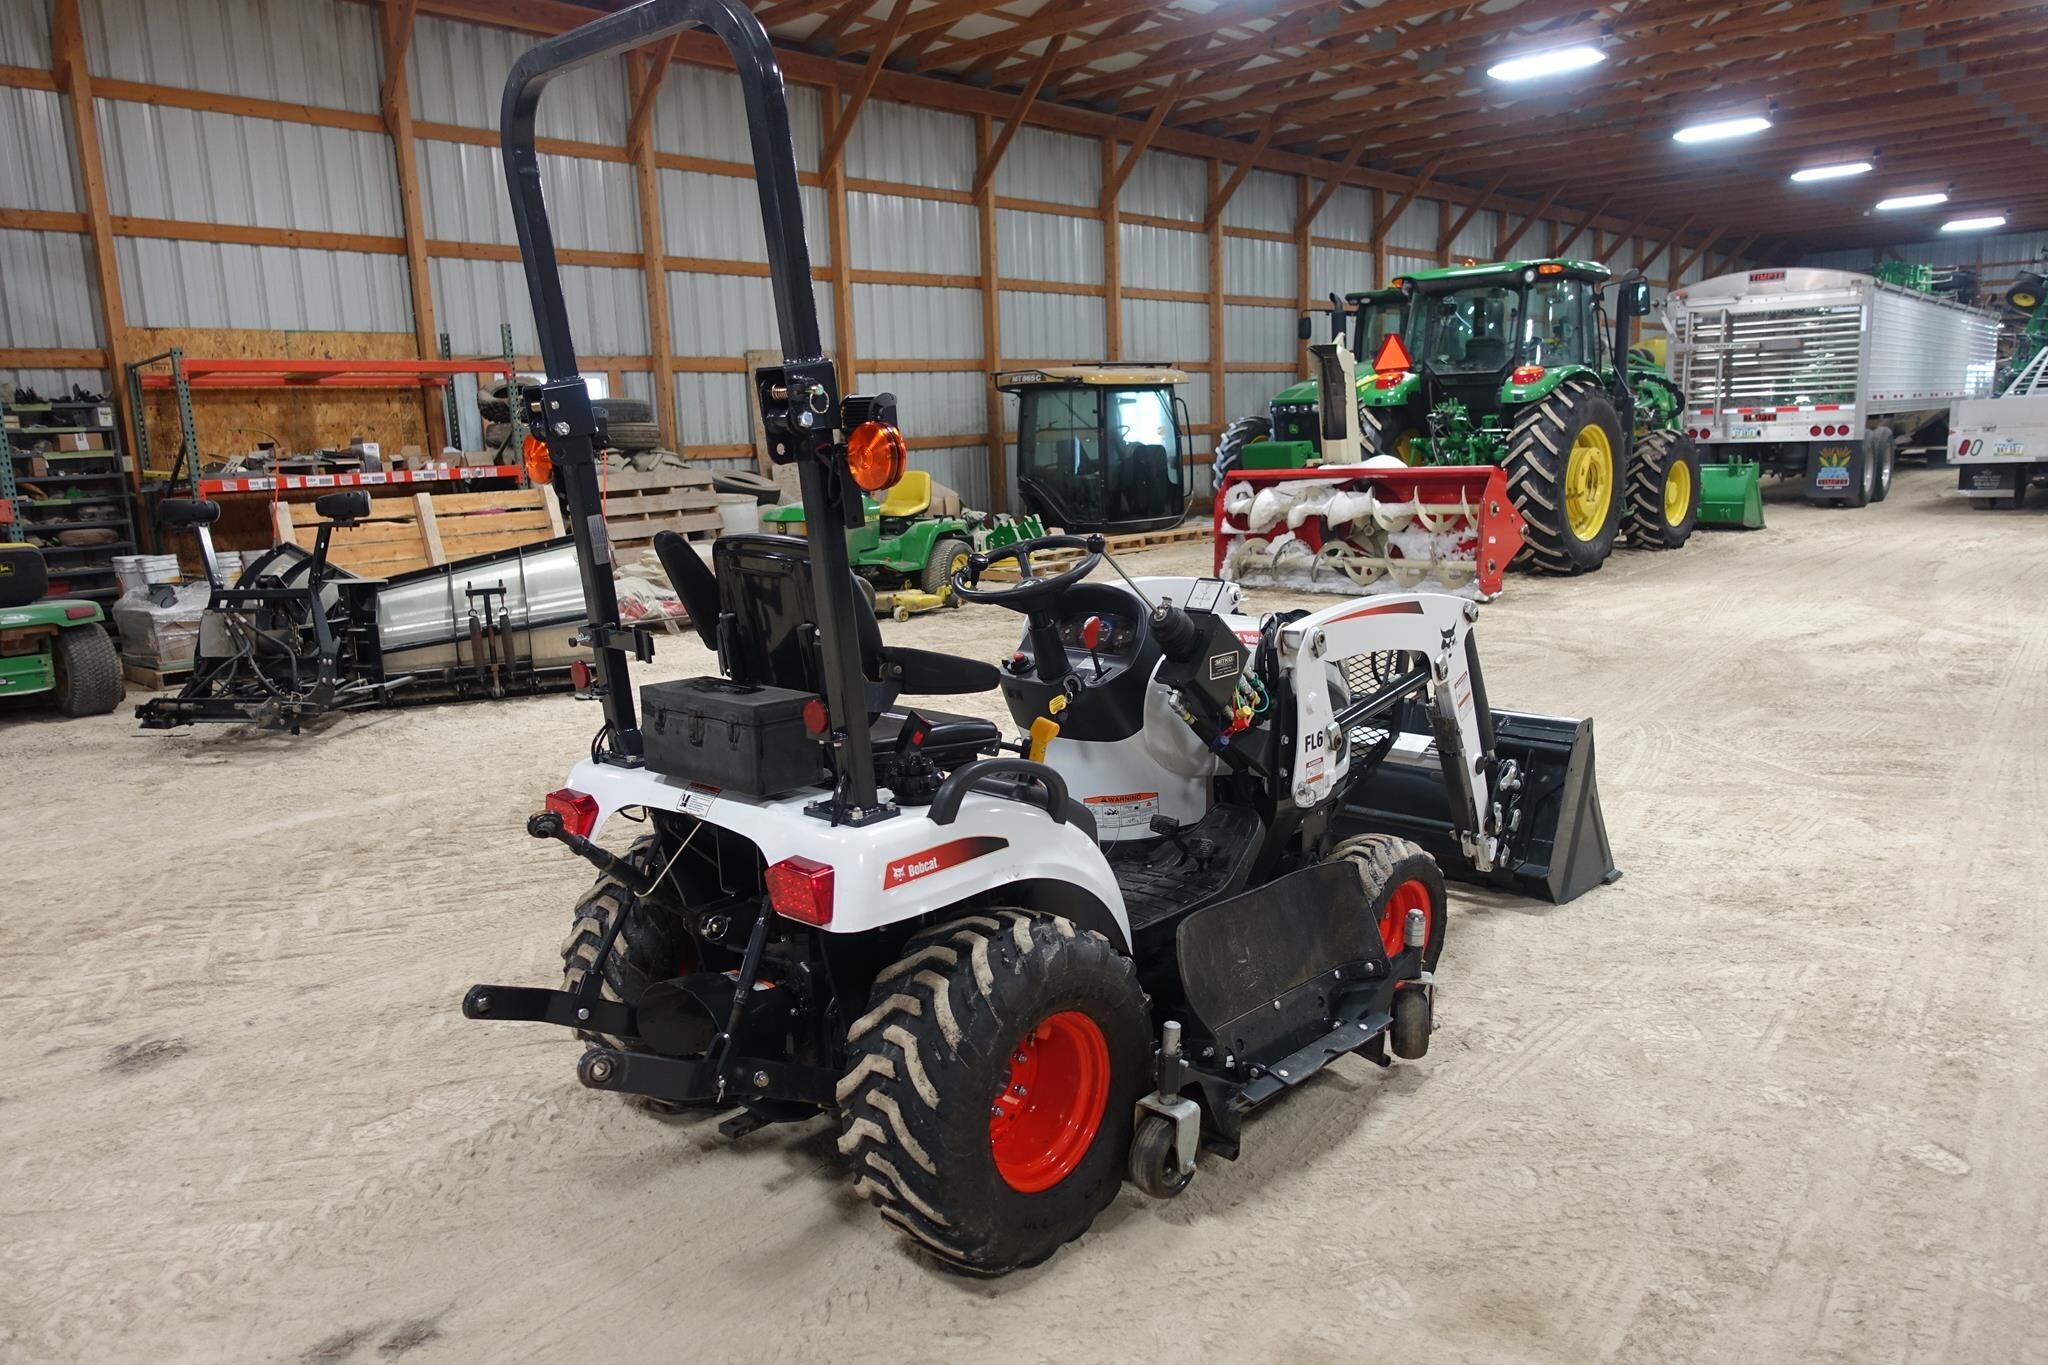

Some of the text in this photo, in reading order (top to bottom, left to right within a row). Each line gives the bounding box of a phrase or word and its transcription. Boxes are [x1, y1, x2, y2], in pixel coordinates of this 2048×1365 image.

[1305, 731, 1323, 752] FL6
[1108, 795, 1142, 803] WARNING
[908, 857, 938, 877] Bobcat
